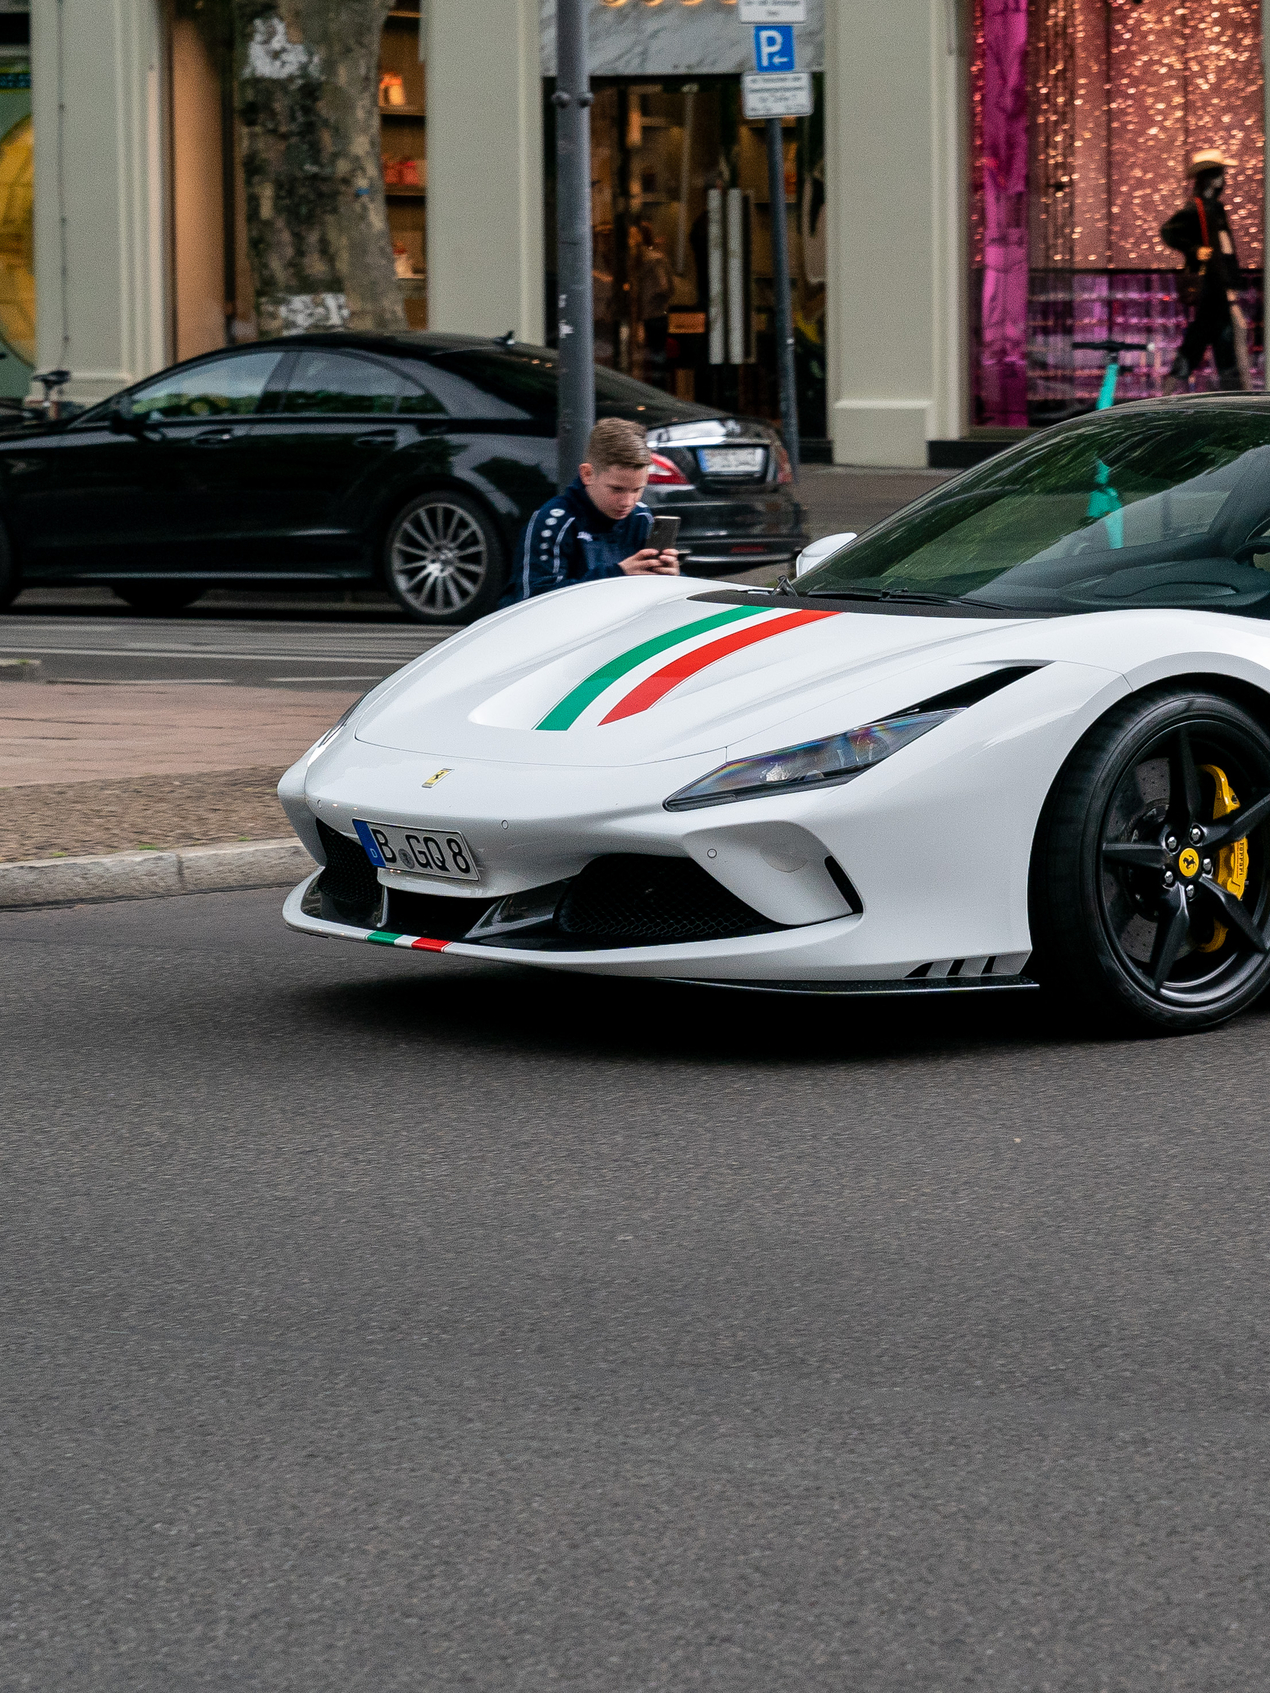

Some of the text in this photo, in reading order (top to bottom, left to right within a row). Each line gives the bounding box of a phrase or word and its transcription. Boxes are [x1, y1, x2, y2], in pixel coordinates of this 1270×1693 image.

[759, 29, 783, 67] P
[371, 828, 471, 874] B GQ 8
